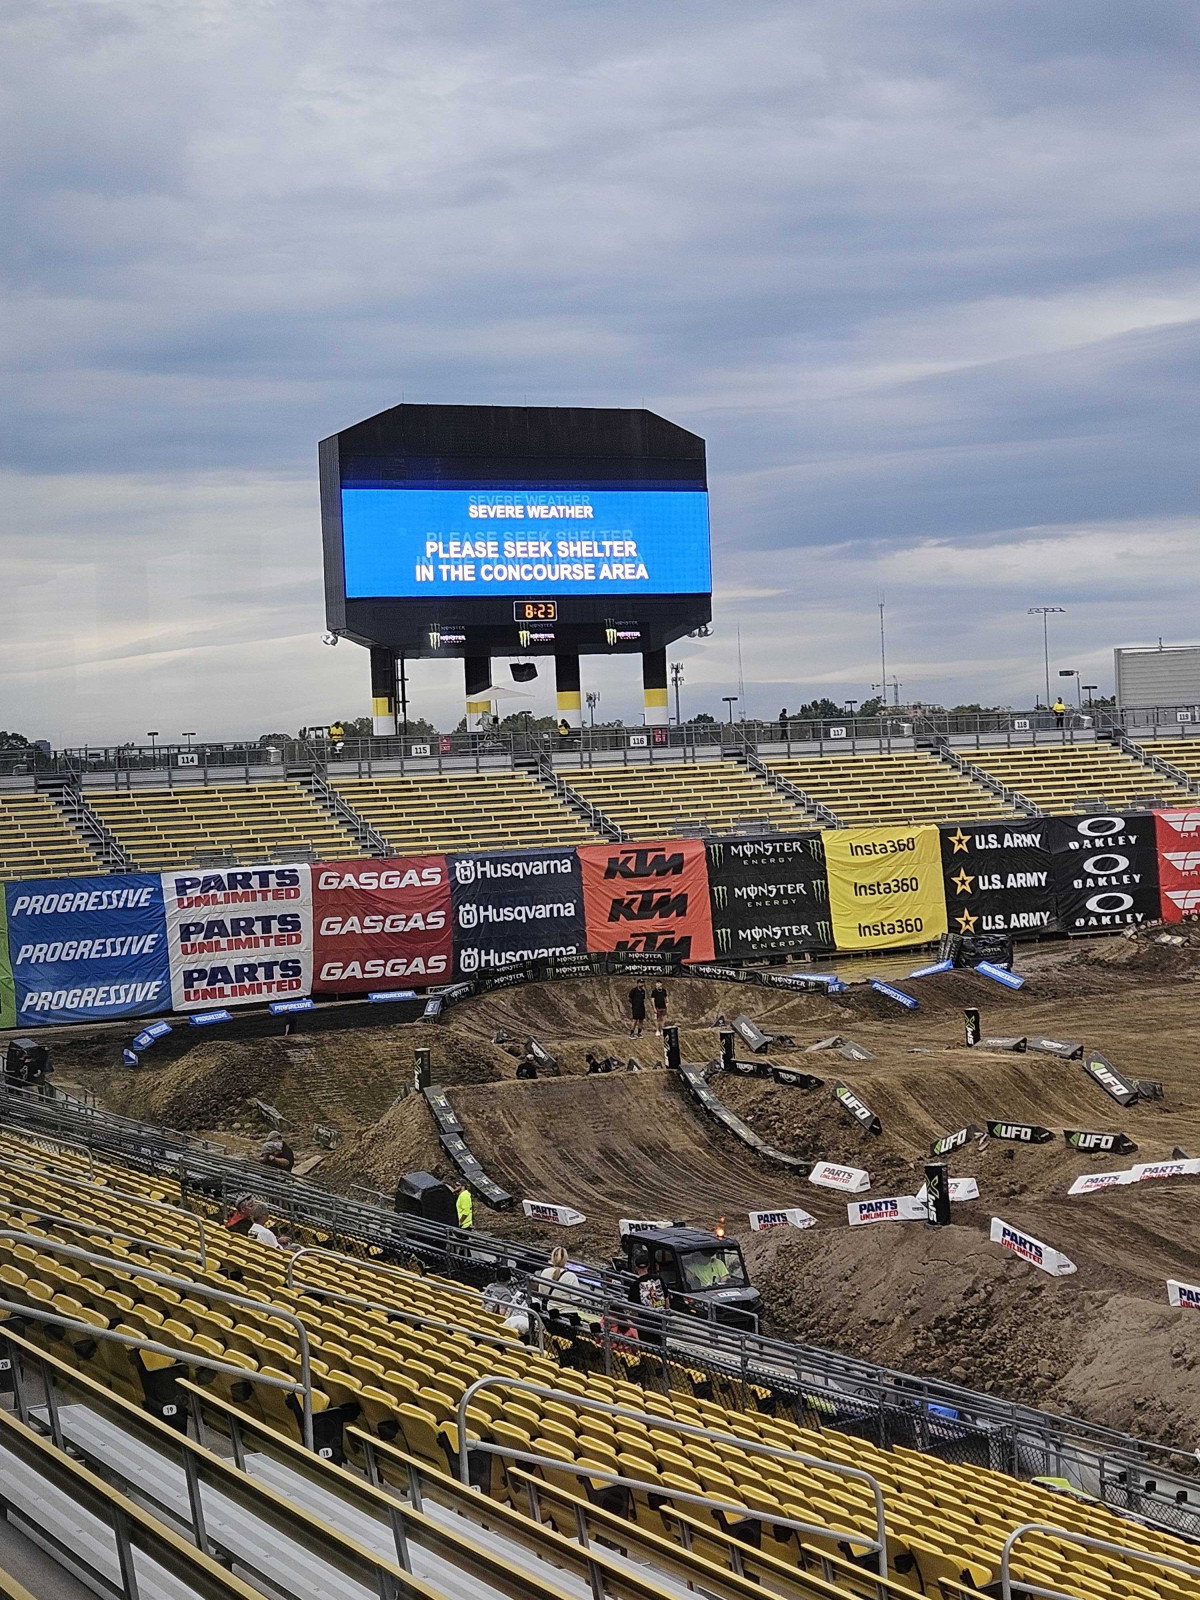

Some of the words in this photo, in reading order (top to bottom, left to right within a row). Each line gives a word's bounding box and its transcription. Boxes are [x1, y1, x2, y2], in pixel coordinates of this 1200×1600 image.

[469, 505, 524, 518] SEVERE
[527, 505, 594, 518] WEATHER
[426, 541, 499, 558] PLEASE
[504, 541, 552, 558] SEEK
[557, 540, 638, 557] SHELTER
[416, 565, 434, 581] IN
[438, 565, 476, 581] THE
[480, 564, 596, 581] CONCOURSE
[600, 563, 650, 580] AREA
[525, 604, 555, 619] 8:23
[632, 737, 645, 745] 116
[832, 728, 844, 737] 117
[414, 746, 428, 755] 115
[181, 755, 195, 765] 114
[730, 841, 803, 858] MONSTER
[975, 834, 1001, 850] U.S.
[1003, 833, 1041, 848] ARMY
[1068, 835, 1138, 850] OAKLEY
[476, 858, 572, 879] Husqvarna
[603, 847, 685, 879] KTM
[743, 856, 793, 866] ENERGY
[174, 868, 300, 896] PARTS
[318, 867, 442, 890] GASGAS
[854, 877, 919, 897] Insta360
[978, 875, 1004, 891] U.S.
[1006, 871, 1048, 888] ARMY
[1073, 874, 1142, 889] OAKLEY
[177, 887, 301, 909] UNLIMITED
[734, 882, 807, 900] MONSTER
[12, 887, 155, 917] PROGRESSIVE
[607, 888, 689, 922] KTM
[747, 898, 797, 908] ENERGY
[480, 902, 576, 923] Husqvarna
[982, 914, 1008, 931] U.S.
[1010, 911, 1050, 928] ARMY
[1075, 912, 1144, 927] OAKLEY
[178, 913, 302, 943] PARTS
[320, 910, 446, 936] GASGAS
[858, 917, 923, 938] Insta360
[738, 924, 812, 942] MONSTER
[15, 933, 159, 965] PROGRESSIVE
[180, 932, 302, 956] UNLIMITED
[752, 939, 804, 950] ENERGY
[183, 959, 302, 990] PARTS
[320, 955, 448, 981] GASGAS
[20, 980, 163, 1013] PROGRESSIVE
[184, 978, 302, 1002] UNLIMITED
[1094, 1067, 1129, 1096] UFO
[840, 1092, 872, 1120] UFO
[940, 1129, 967, 1152] UFO
[1000, 1126, 1031, 1141] UFO
[1077, 1133, 1114, 1149] UFO
[819, 1173, 851, 1184] UNLIMITED
[822, 1166, 854, 1180] PARTS
[1142, 1164, 1185, 1175] PARTS
[530, 1204, 558, 1217] PARTS
[858, 1199, 898, 1214] PARTS
[859, 1209, 899, 1221] UNLIMITED
[757, 1212, 788, 1224] PARTS
[1001, 1226, 1043, 1258] PARTS
[1001, 1237, 1043, 1265] UNLIMITED
[166, 1406, 174, 1414] 19
